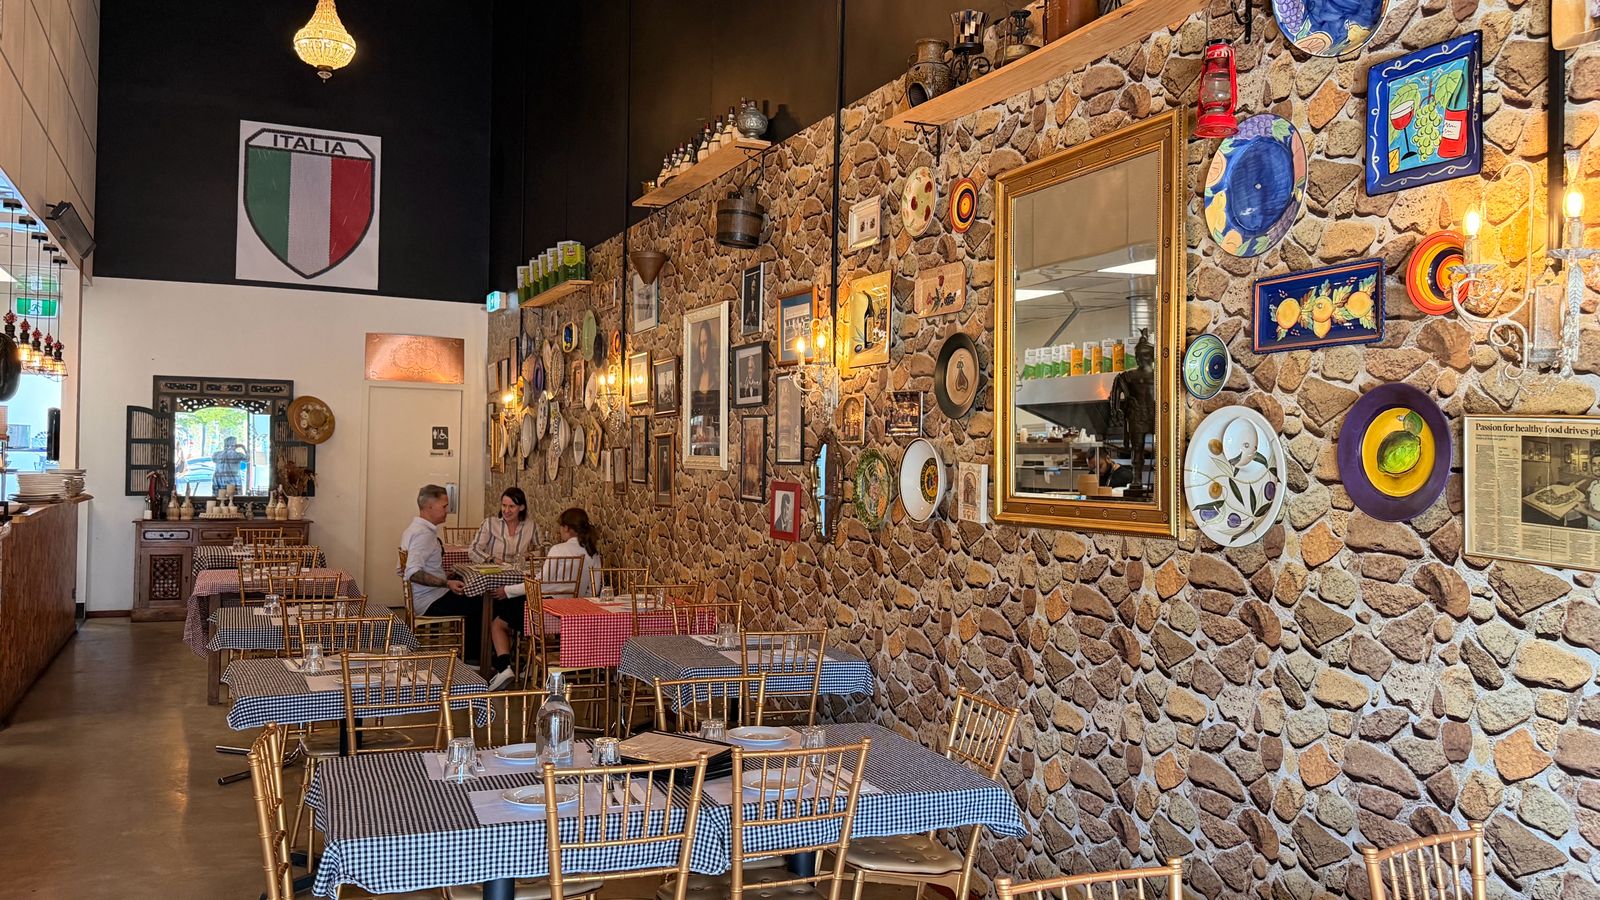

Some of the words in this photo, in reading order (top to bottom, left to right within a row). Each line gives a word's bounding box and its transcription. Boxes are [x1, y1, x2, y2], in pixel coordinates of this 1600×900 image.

[273, 134, 347, 155] ITALIA
[1475, 423, 1502, 432] Passion
[1503, 424, 1514, 432] for
[1515, 424, 1543, 435] healthy
[1544, 425, 1562, 434] food
[1564, 426, 1589, 435] drives
